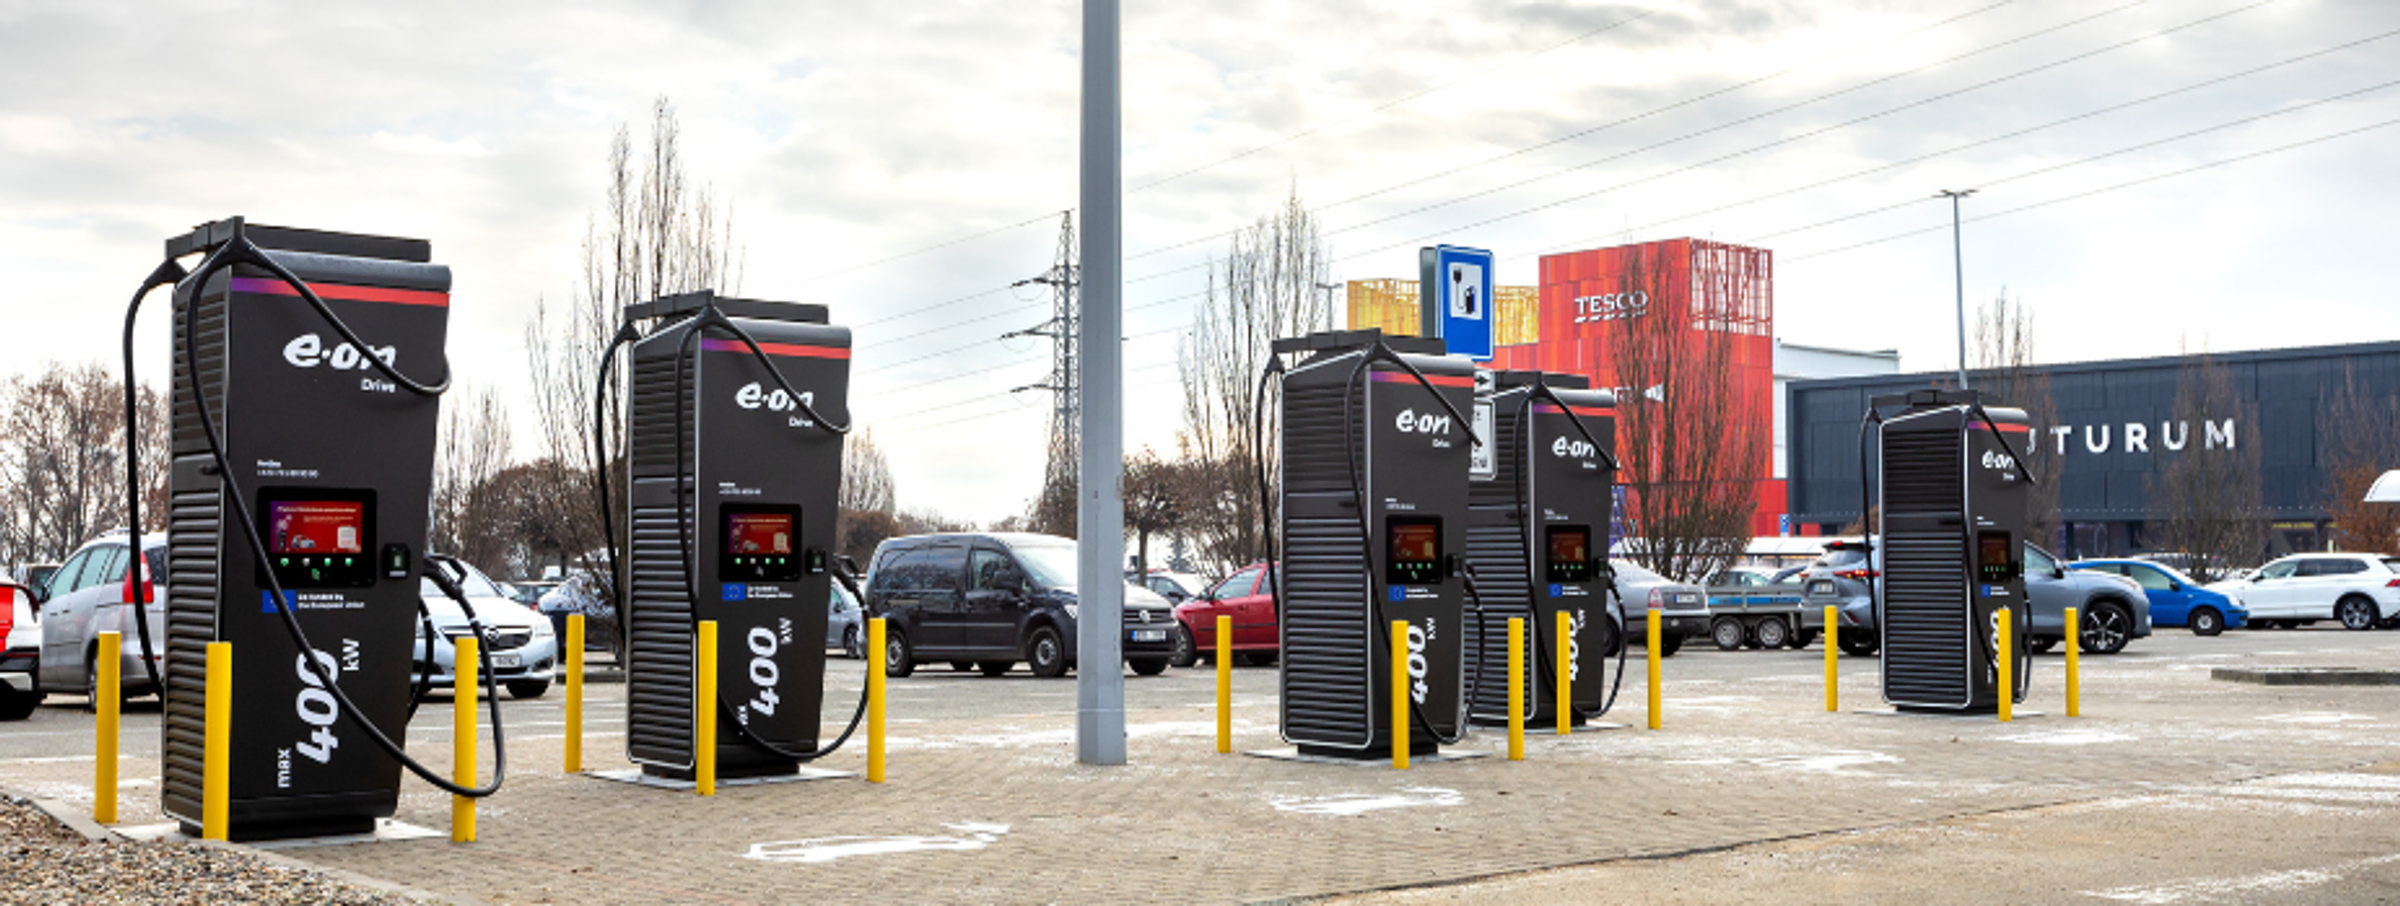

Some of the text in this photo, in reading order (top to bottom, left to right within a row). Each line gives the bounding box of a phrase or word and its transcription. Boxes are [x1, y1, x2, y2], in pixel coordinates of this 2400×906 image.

[1574, 290, 1649, 315] TESCO
[361, 378, 396, 393] Drive
[342, 638, 360, 671] kW
[747, 626, 779, 716] 400
[1408, 625, 1429, 704] 400
[295, 648, 339, 764] 400
[277, 747, 292, 789] max
